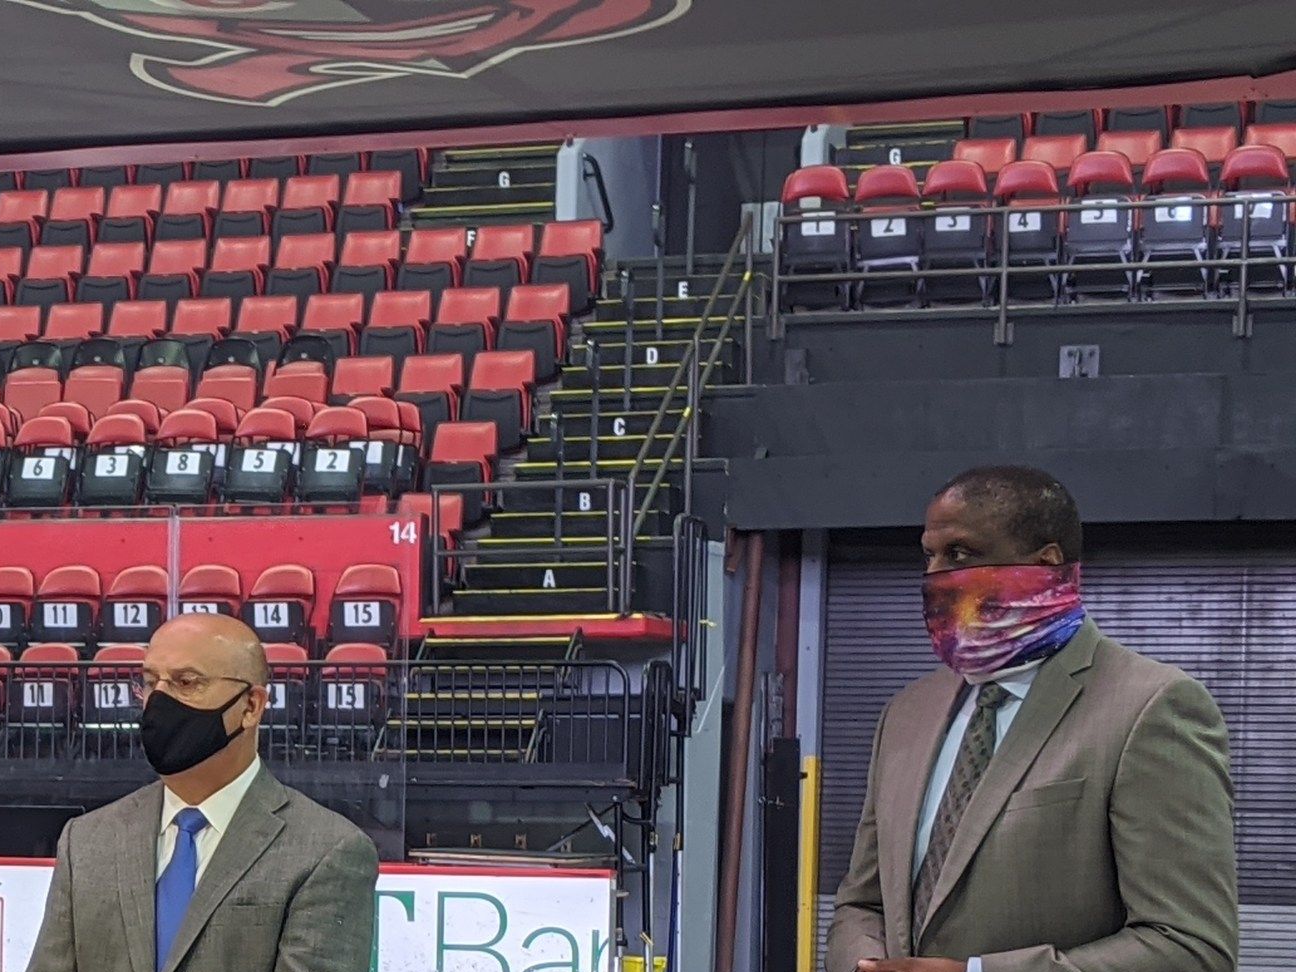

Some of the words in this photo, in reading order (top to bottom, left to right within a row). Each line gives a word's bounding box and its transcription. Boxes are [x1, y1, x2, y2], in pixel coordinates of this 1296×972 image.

[889, 148, 901, 165] G
[498, 172, 510, 189] G
[1018, 214, 1029, 229] 4
[467, 231, 476, 247] F
[679, 282, 688, 299] E
[647, 347, 658, 364] D
[614, 418, 625, 436] C
[33, 460, 43, 476] 6
[106, 457, 116, 474] 3
[178, 453, 189, 471] 8
[254, 452, 264, 469] 5
[326, 452, 338, 470] 2
[579, 492, 590, 510] B
[389, 521, 417, 544] 14
[543, 569, 555, 588] A
[52, 606, 67, 624] 11
[123, 605, 141, 625] 12
[263, 605, 282, 624] 14
[354, 604, 373, 623] 15
